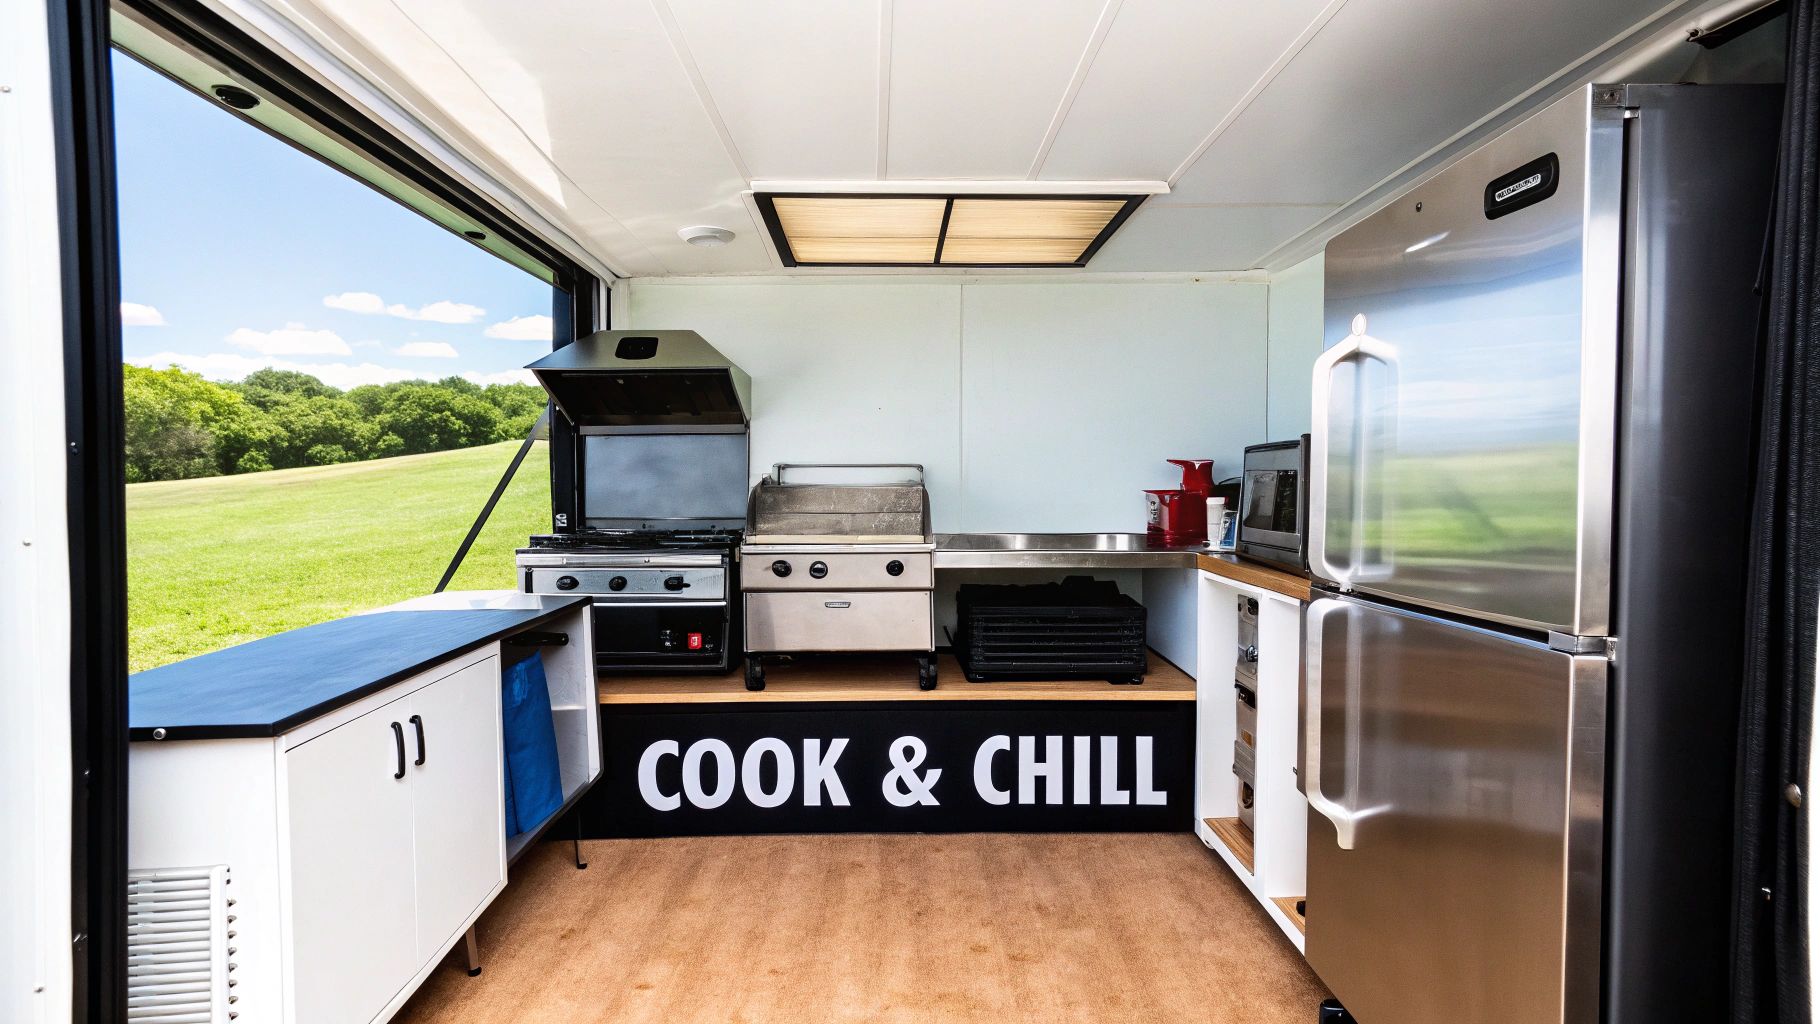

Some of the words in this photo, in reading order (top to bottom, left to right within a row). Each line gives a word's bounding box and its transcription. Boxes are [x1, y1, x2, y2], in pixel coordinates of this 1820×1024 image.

[637, 738, 851, 812] COOK
[881, 735, 943, 808] &
[972, 734, 1167, 807] CHILL
